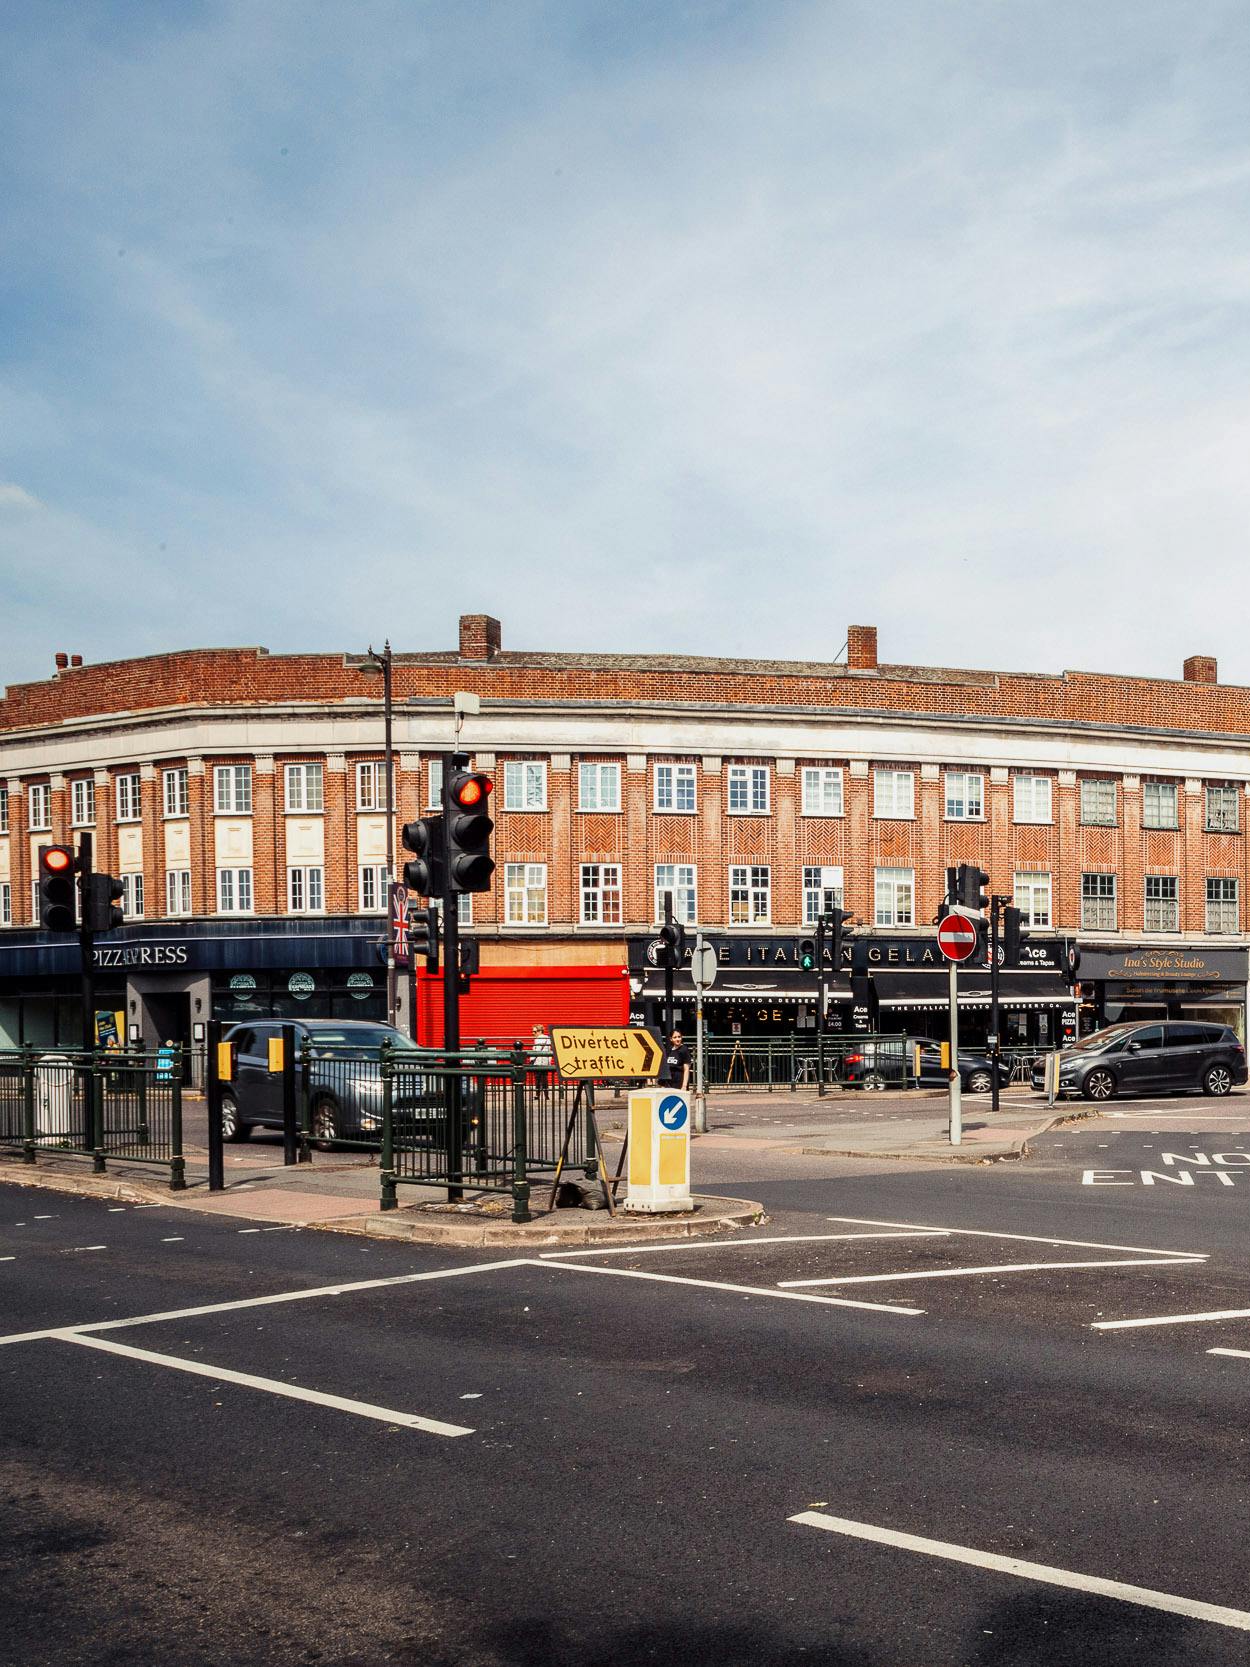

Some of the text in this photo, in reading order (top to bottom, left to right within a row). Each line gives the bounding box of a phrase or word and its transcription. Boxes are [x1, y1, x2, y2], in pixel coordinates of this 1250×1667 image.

[684, 946, 730, 961] AE
[746, 946, 852, 961] ITALAN
[868, 946, 946, 962] GELA
[1124, 957, 1205, 970] Ina's Style Studio
[560, 1033, 629, 1049] Diverted
[574, 1055, 625, 1070] traffic
